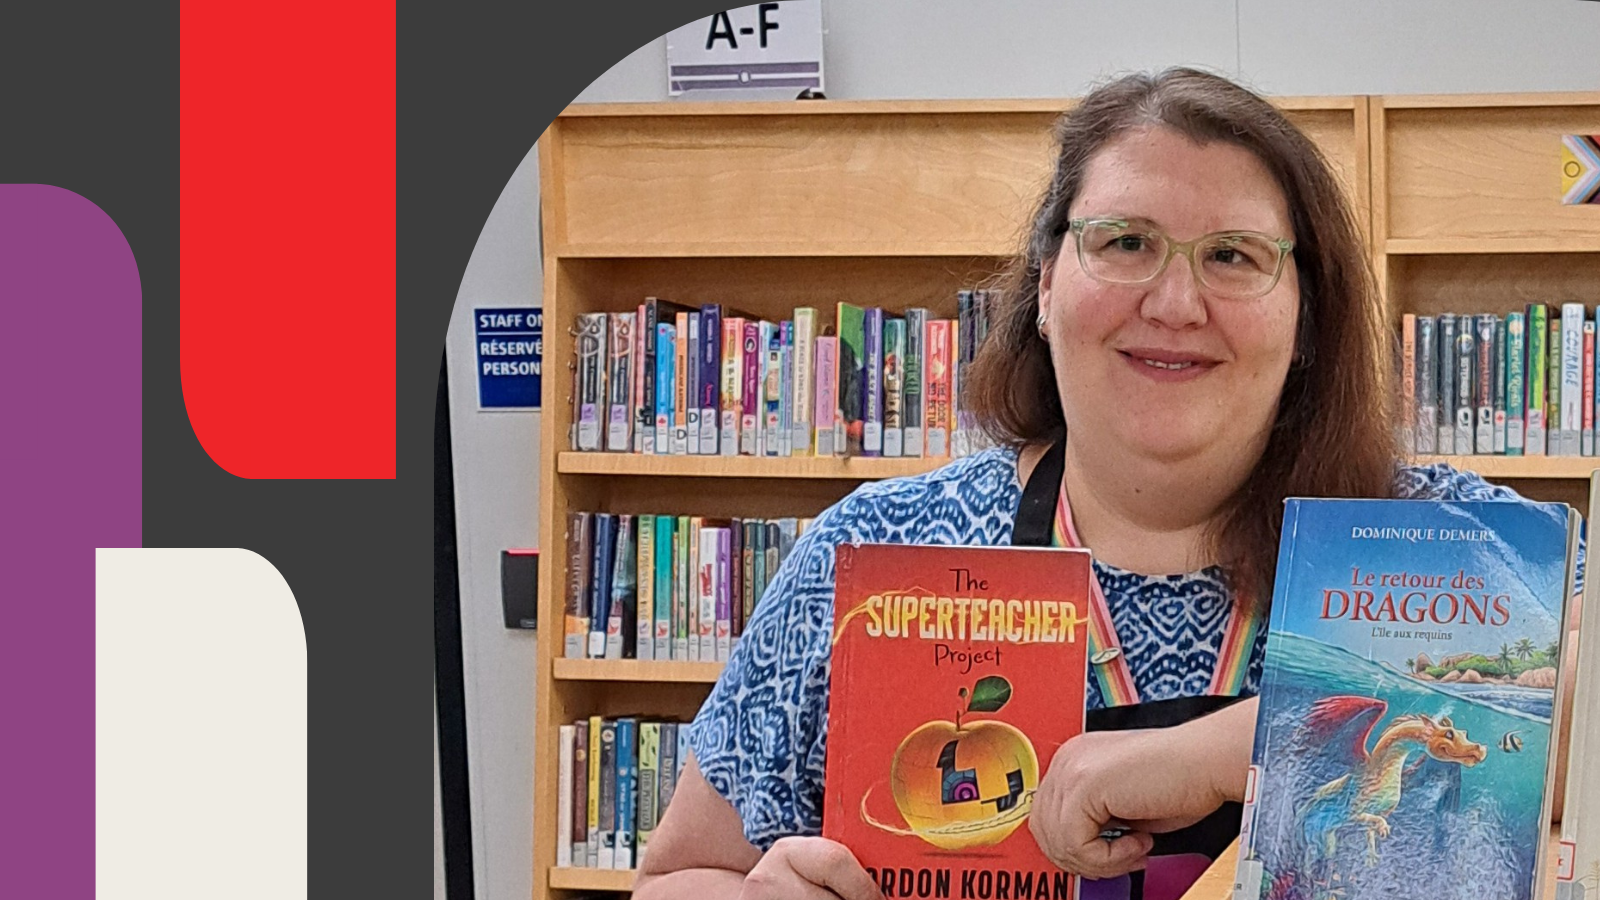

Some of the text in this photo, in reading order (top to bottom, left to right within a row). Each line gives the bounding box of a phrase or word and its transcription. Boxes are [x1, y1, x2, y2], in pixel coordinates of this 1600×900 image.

[706, 3, 779, 50] A-F
[480, 313, 522, 328] STAFF
[1351, 526, 1496, 543] DOMINIQUE DEMERS
[949, 568, 989, 593] The
[1351, 566, 1485, 591] Le retour des
[865, 595, 1078, 644] SUPERTEACHER
[1319, 588, 1511, 627] DRAGONS
[1394, 629, 1412, 640] aux
[1414, 628, 1453, 643] requins
[934, 643, 1003, 675] Project
[961, 869, 1069, 900] KORMAN
